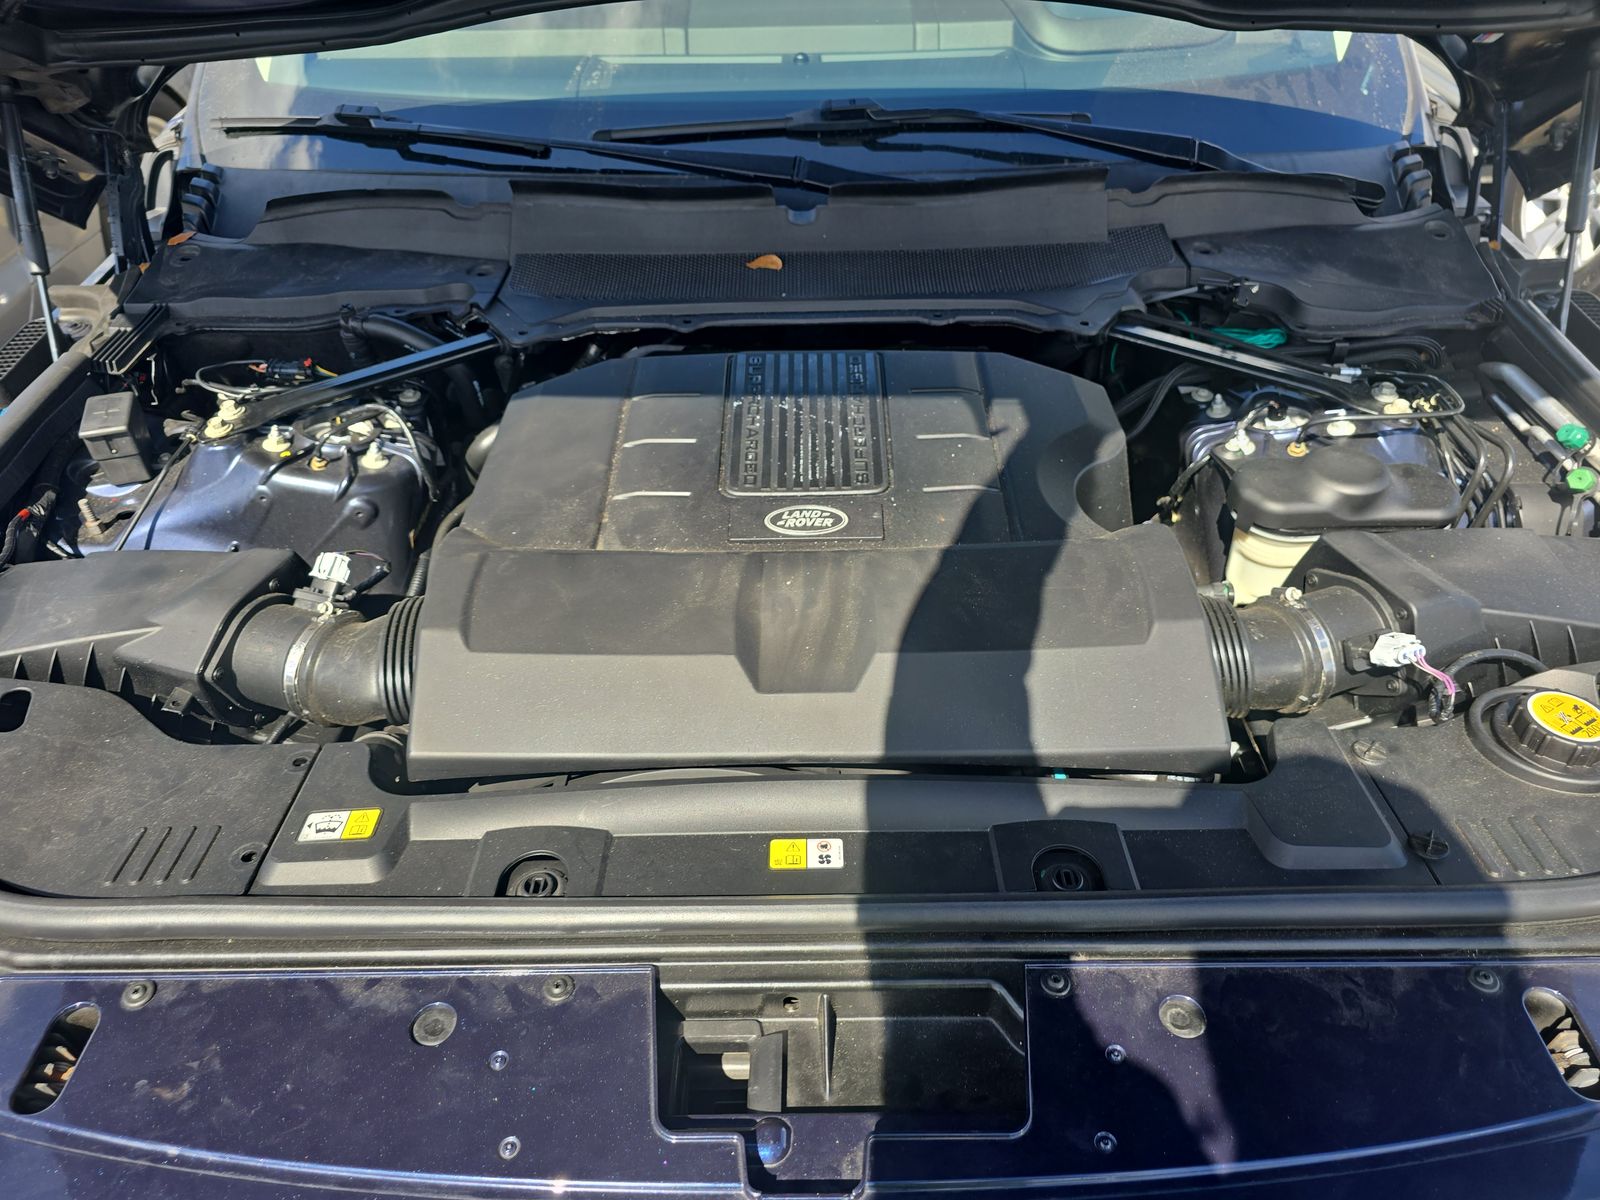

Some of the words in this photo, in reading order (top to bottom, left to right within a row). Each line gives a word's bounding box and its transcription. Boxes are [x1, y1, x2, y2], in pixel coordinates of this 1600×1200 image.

[744, 356, 761, 485] SUPERCHARGED
[849, 355, 869, 484] SUPERCHARGED
[784, 518, 834, 527] ROVER
